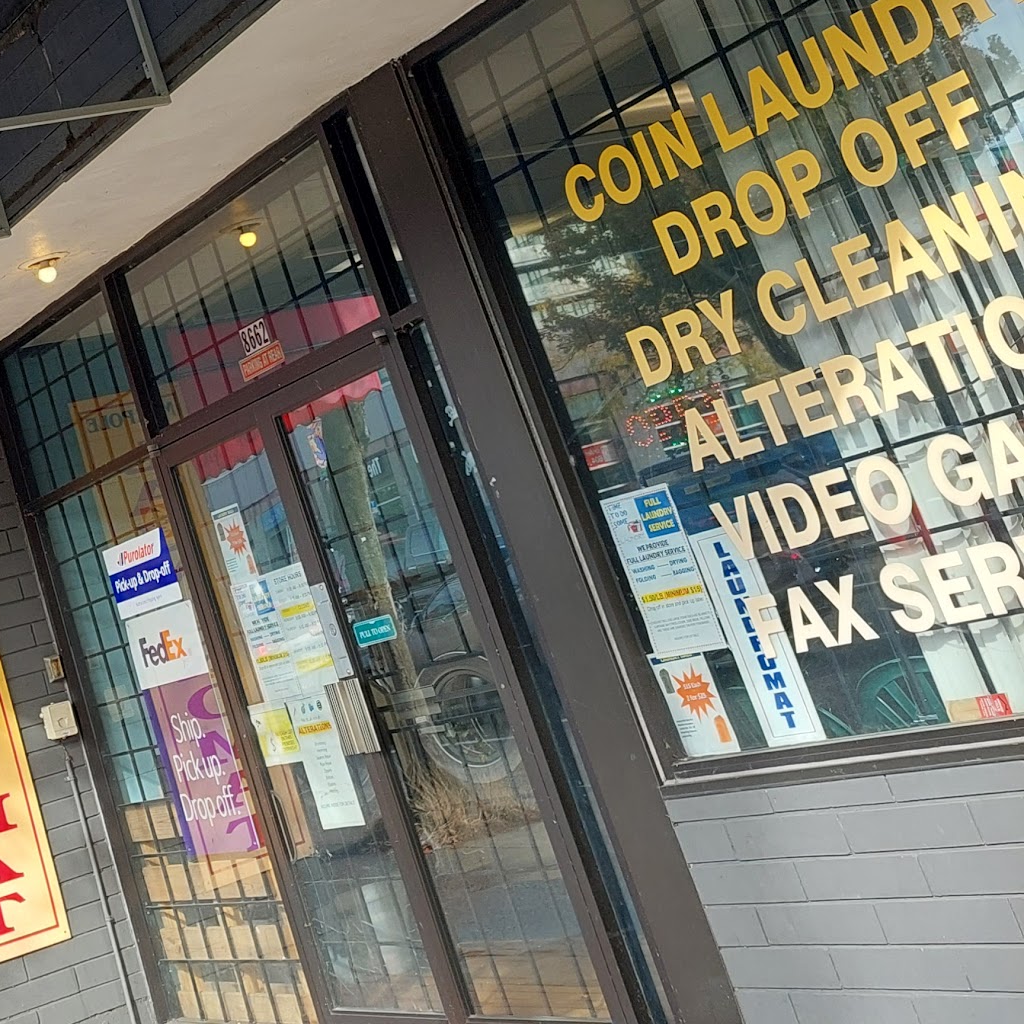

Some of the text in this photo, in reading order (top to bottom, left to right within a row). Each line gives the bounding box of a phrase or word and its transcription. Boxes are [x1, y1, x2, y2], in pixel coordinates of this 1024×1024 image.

[565, 110, 703, 222] COIN
[652, 69, 979, 275] DROP OFF
[241, 321, 269, 353] 8662
[625, 289, 742, 388] DRY
[641, 507, 673, 521] LAUNDRY
[643, 497, 661, 507] FULL
[709, 456, 913, 560] VIDEO
[649, 519, 675, 532] SERVICE
[123, 543, 154, 563] Purolator
[626, 545, 686, 564] FULL LAUNDRY SERVICE
[637, 539, 670, 552] WE PROVIDE
[115, 560, 171, 594] Pick-up & Drop-off
[632, 564, 655, 574] WASHING
[636, 574, 657, 583] FOLDING
[746, 574, 880, 659] FAX
[139, 630, 187, 668] FedEx
[170, 711, 206, 747] Ship.
[298, 722, 332, 735] ALTERATIONS
[173, 751, 226, 785] Pick up.
[180, 784, 241, 826] Drop off.
